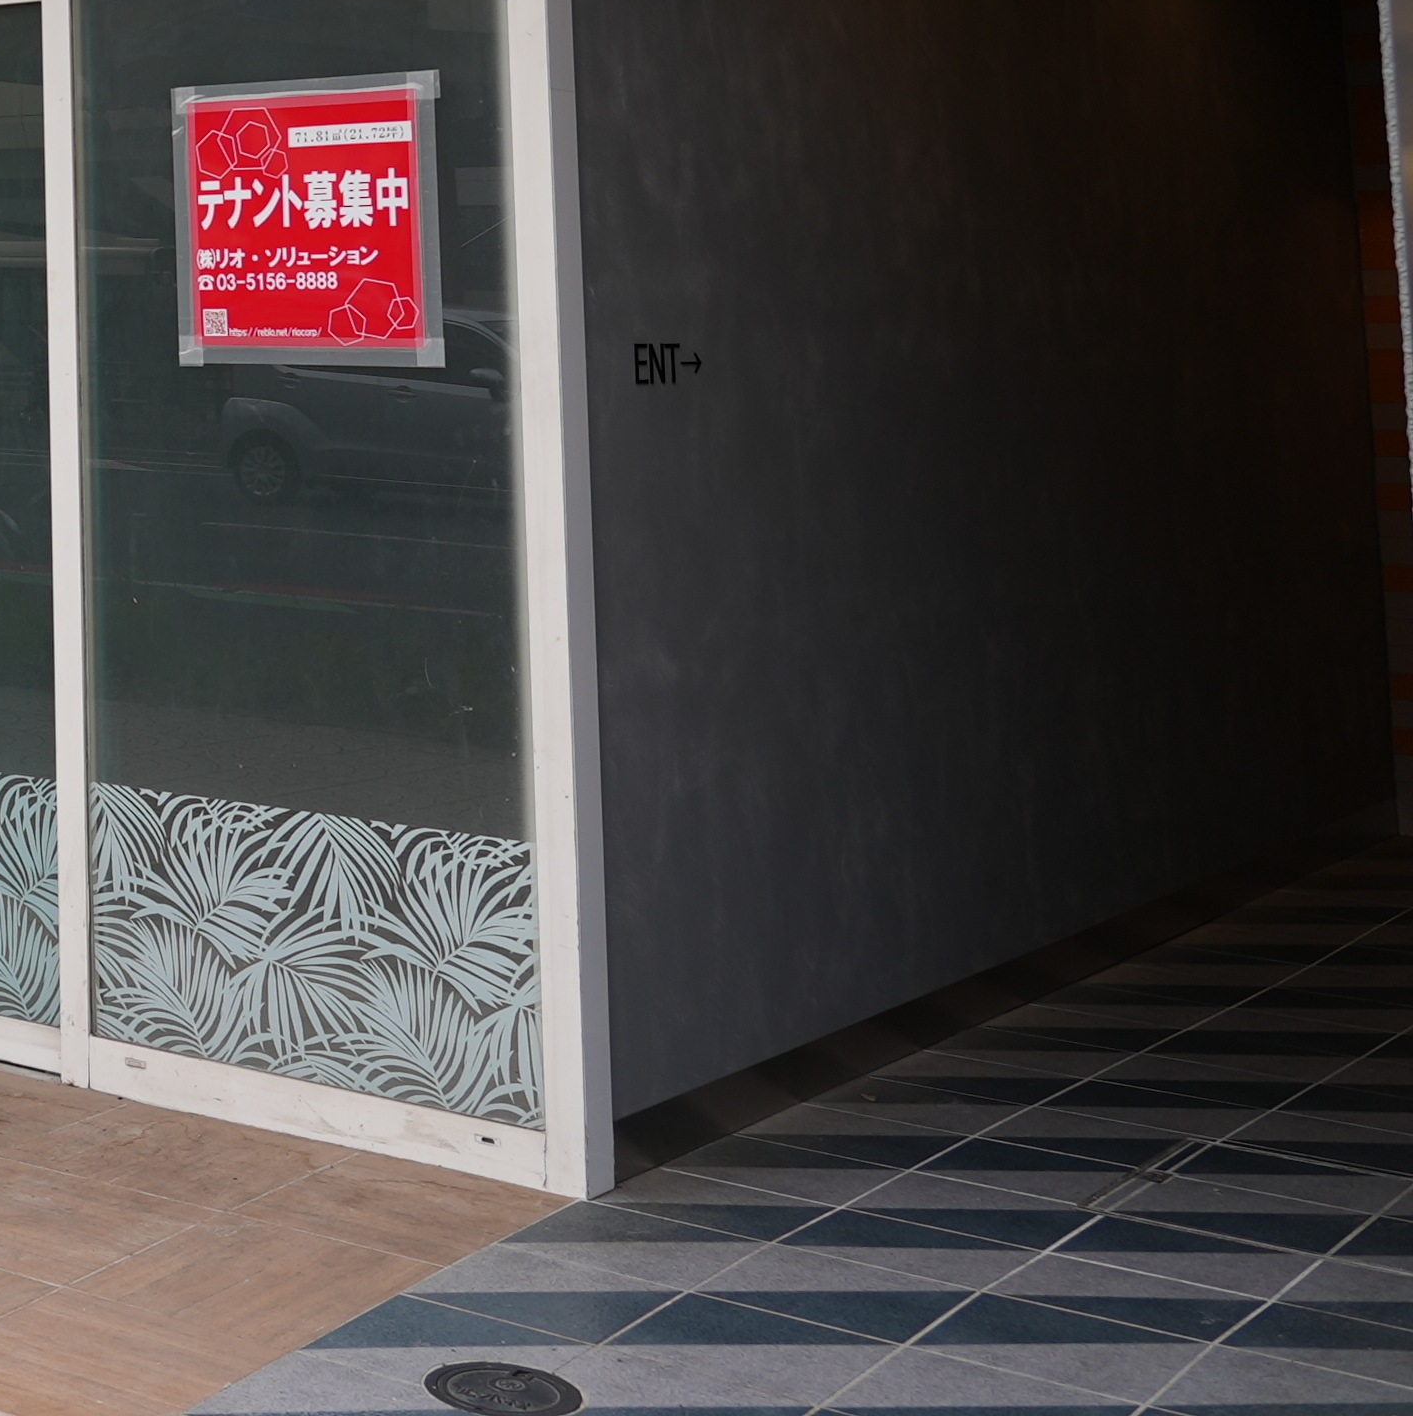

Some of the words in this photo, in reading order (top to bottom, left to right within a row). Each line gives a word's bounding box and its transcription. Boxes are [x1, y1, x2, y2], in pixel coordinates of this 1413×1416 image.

[197, 167, 410, 231] テナント募集中
[217, 270, 339, 291] 03-5156-8888
[633, 342, 681, 385] ENT
